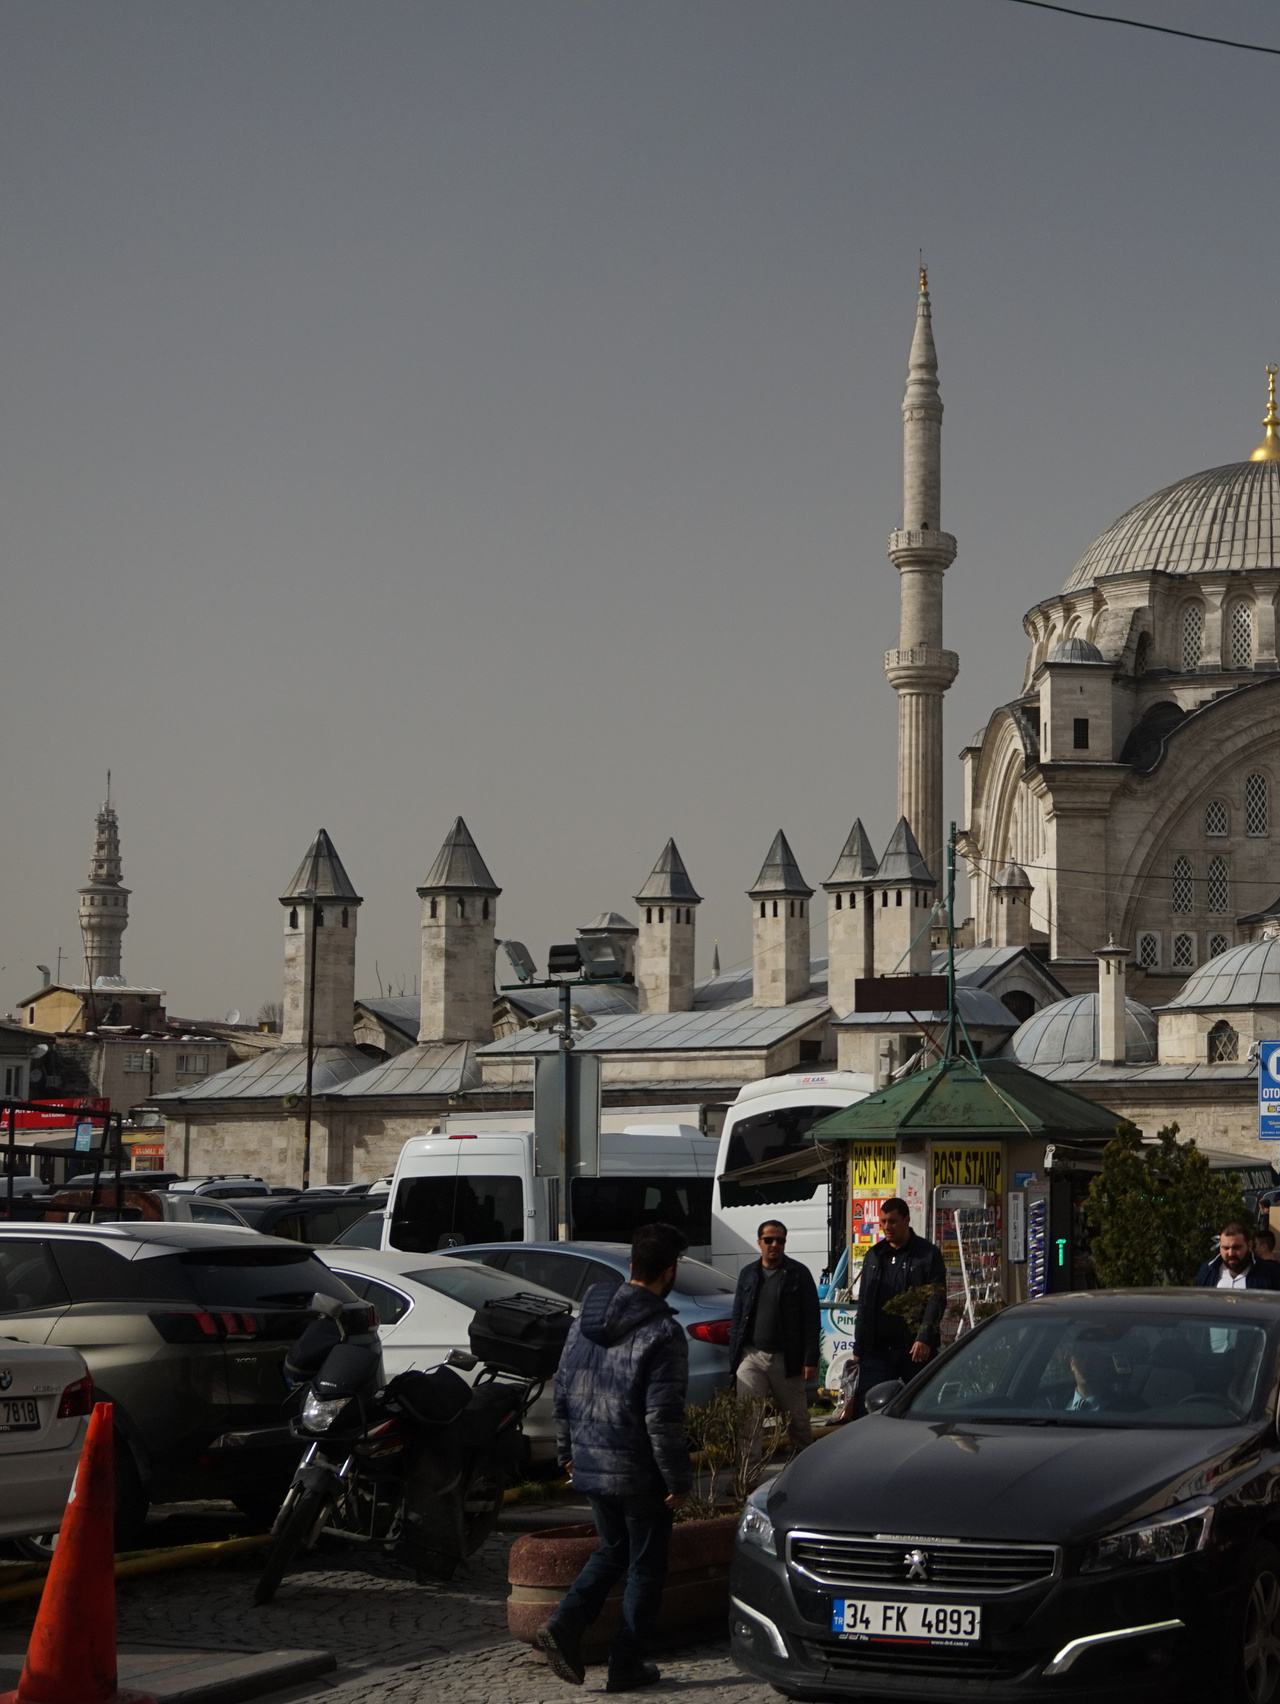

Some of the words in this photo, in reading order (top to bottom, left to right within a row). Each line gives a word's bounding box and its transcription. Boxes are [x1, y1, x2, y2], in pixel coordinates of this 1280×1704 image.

[854, 1145, 872, 1186] POST
[873, 1145, 897, 1186] STAMP
[933, 1151, 962, 1188] POST
[964, 1151, 1001, 1189] STAMP
[864, 1200, 880, 1223] CALL
[3, 1401, 36, 1423] 7818
[834, 1616, 844, 1626] TR
[846, 1603, 871, 1630] 34
[882, 1604, 908, 1632] FK
[921, 1606, 976, 1636] 4893
